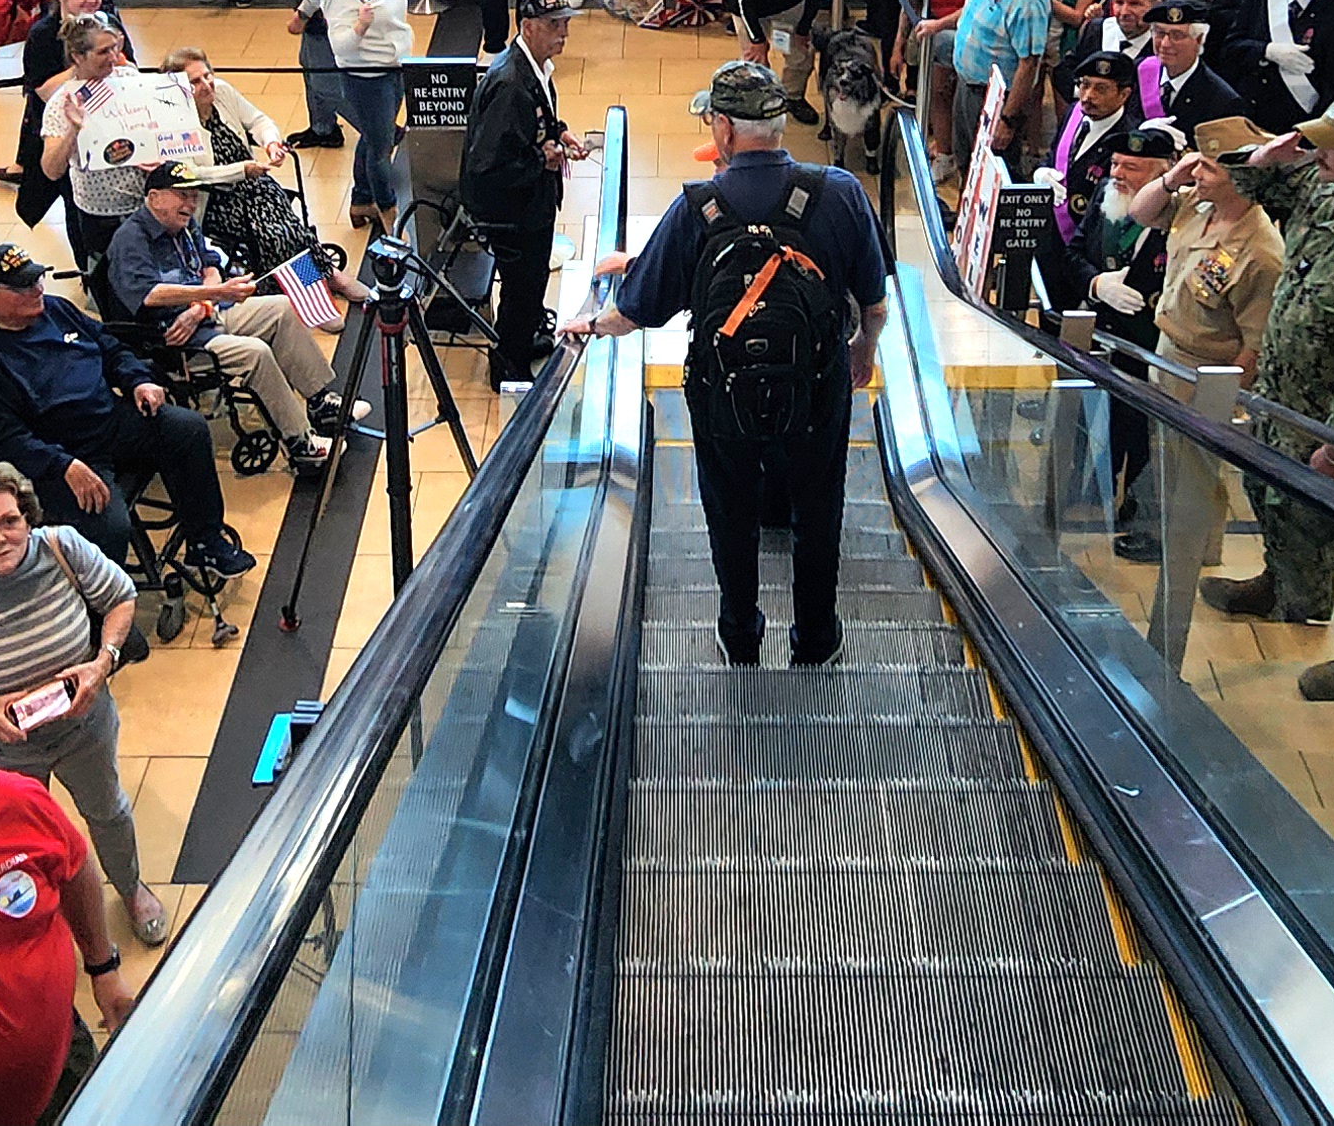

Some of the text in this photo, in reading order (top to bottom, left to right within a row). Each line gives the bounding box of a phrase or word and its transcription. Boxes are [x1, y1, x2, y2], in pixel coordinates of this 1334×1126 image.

[430, 73, 448, 84] NO
[413, 87, 467, 98] RE-ENTRY
[419, 101, 465, 112] BEYOND
[412, 114, 468, 125] THIS POIN
[160, 144, 204, 157] America
[1000, 194, 1052, 205] EXIT ONLY
[1016, 209, 1032, 217] NO
[1000, 219, 1047, 228] RE-ENTRY
[1016, 229, 1029, 238] TO
[1005, 239, 1037, 248] GATES
